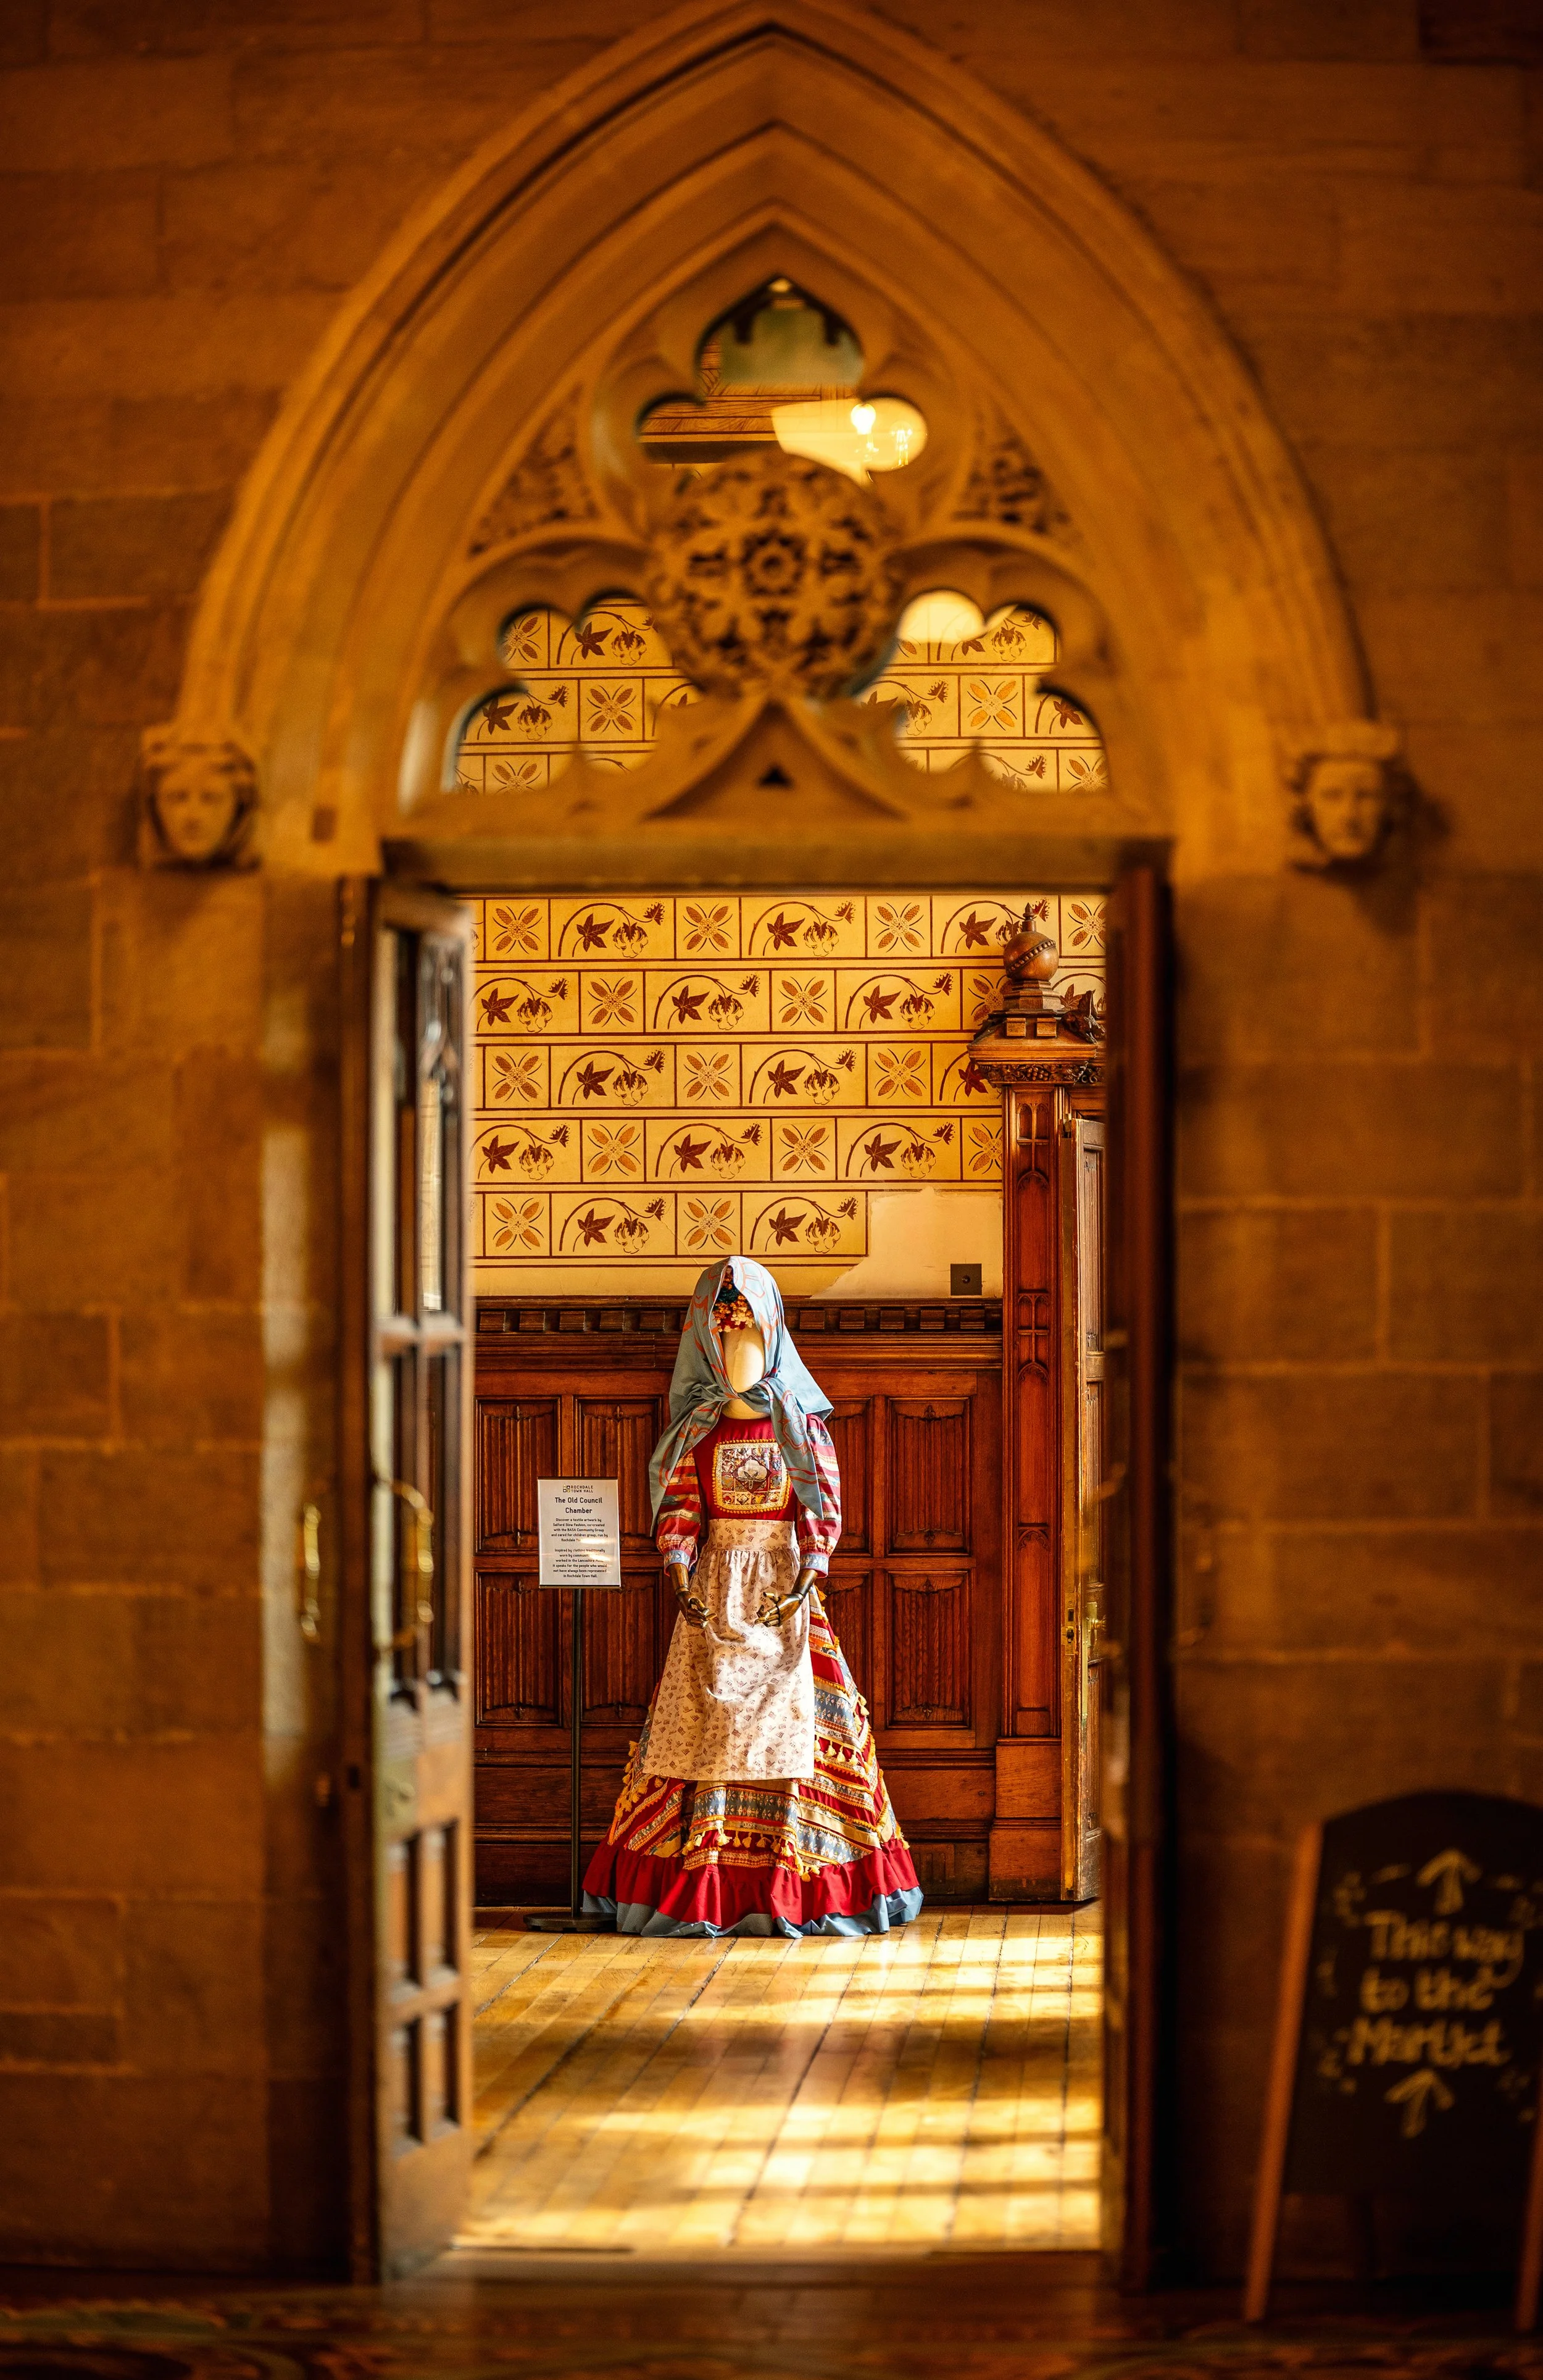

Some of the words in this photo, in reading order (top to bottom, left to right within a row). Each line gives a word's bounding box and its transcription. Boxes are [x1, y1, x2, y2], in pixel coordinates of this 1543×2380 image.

[1363, 1910, 1450, 1960] This
[1359, 1966, 1410, 2013] to
[1415, 1966, 1494, 2011] the
